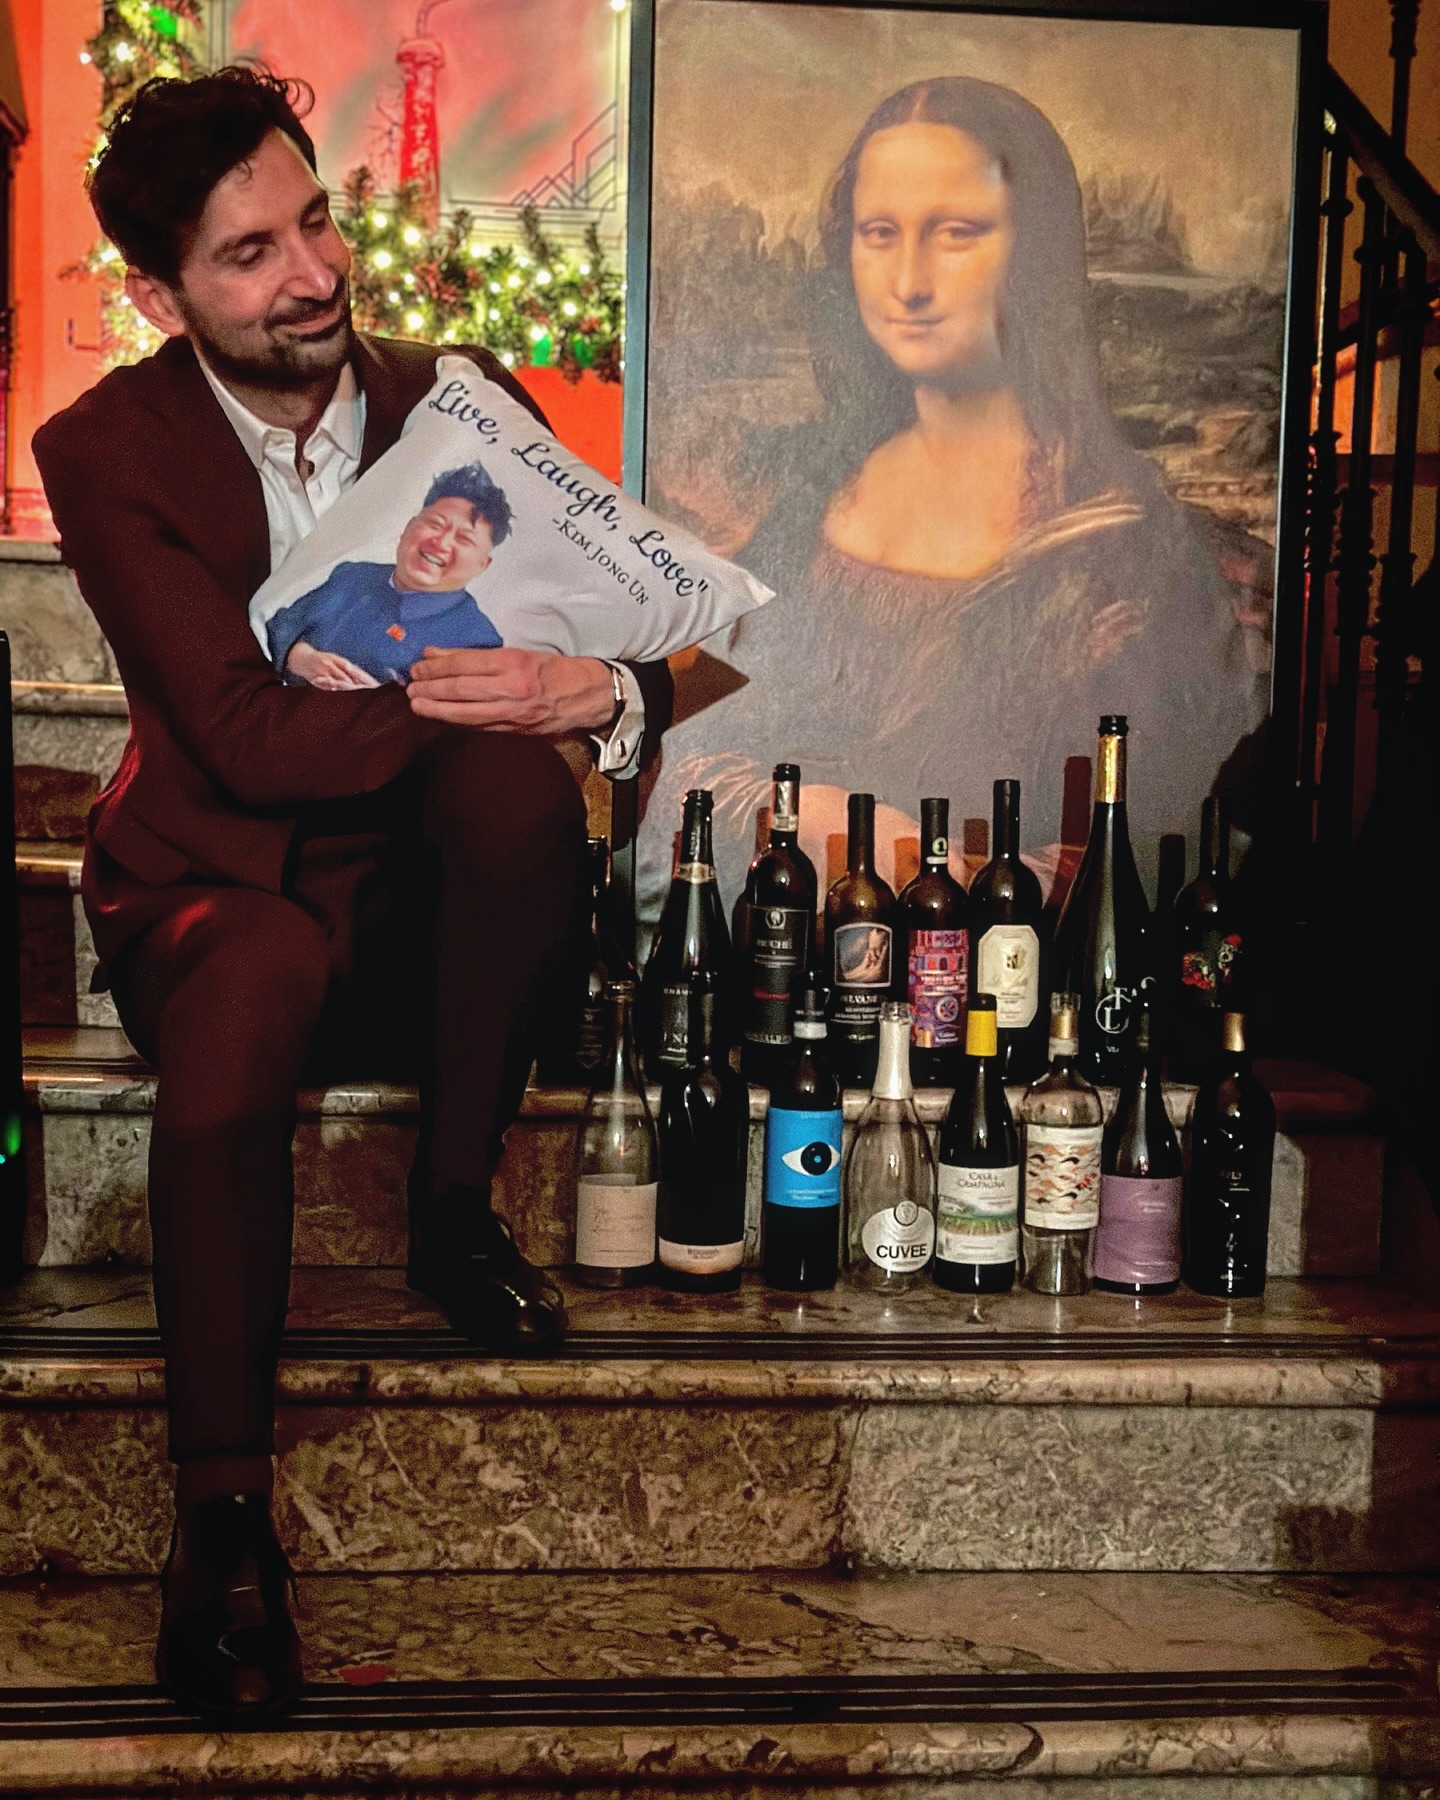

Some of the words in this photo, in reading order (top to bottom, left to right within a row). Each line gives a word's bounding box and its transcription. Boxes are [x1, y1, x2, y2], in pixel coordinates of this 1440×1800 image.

[428, 380, 500, 445] Live,
[510, 442, 621, 531] Laugh,
[628, 530, 709, 597] Love"
[875, 1243, 928, 1260] CUVEE
